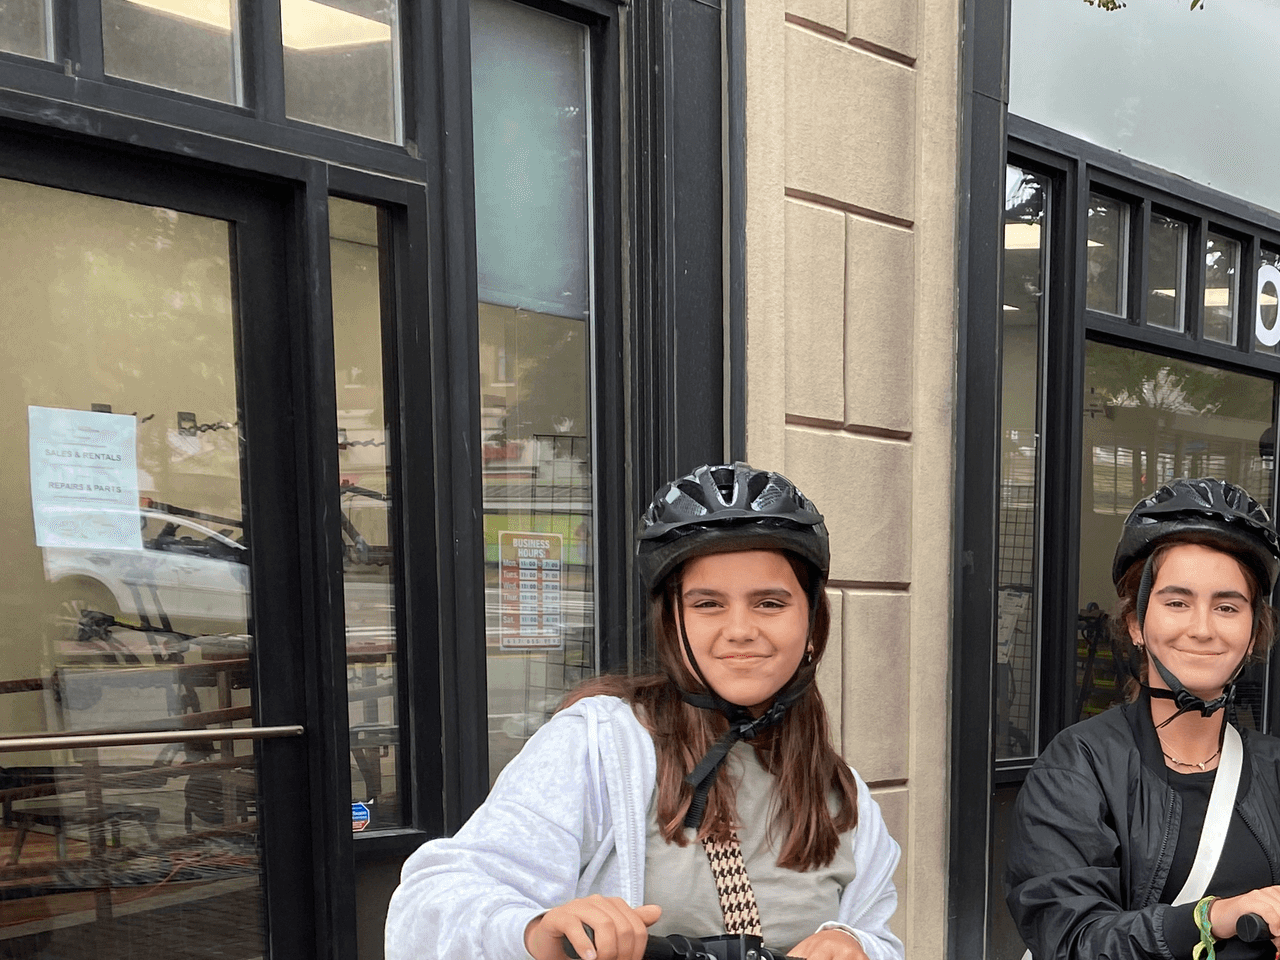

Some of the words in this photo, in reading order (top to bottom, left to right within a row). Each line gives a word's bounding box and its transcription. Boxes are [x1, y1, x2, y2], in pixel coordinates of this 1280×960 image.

[45, 448, 73, 458] SALES
[74, 451, 81, 459] &
[82, 451, 122, 462] RENTALS
[48, 481, 84, 491] REPAIRS
[94, 484, 122, 494] PARTS
[512, 538, 550, 549] BUSINESS
